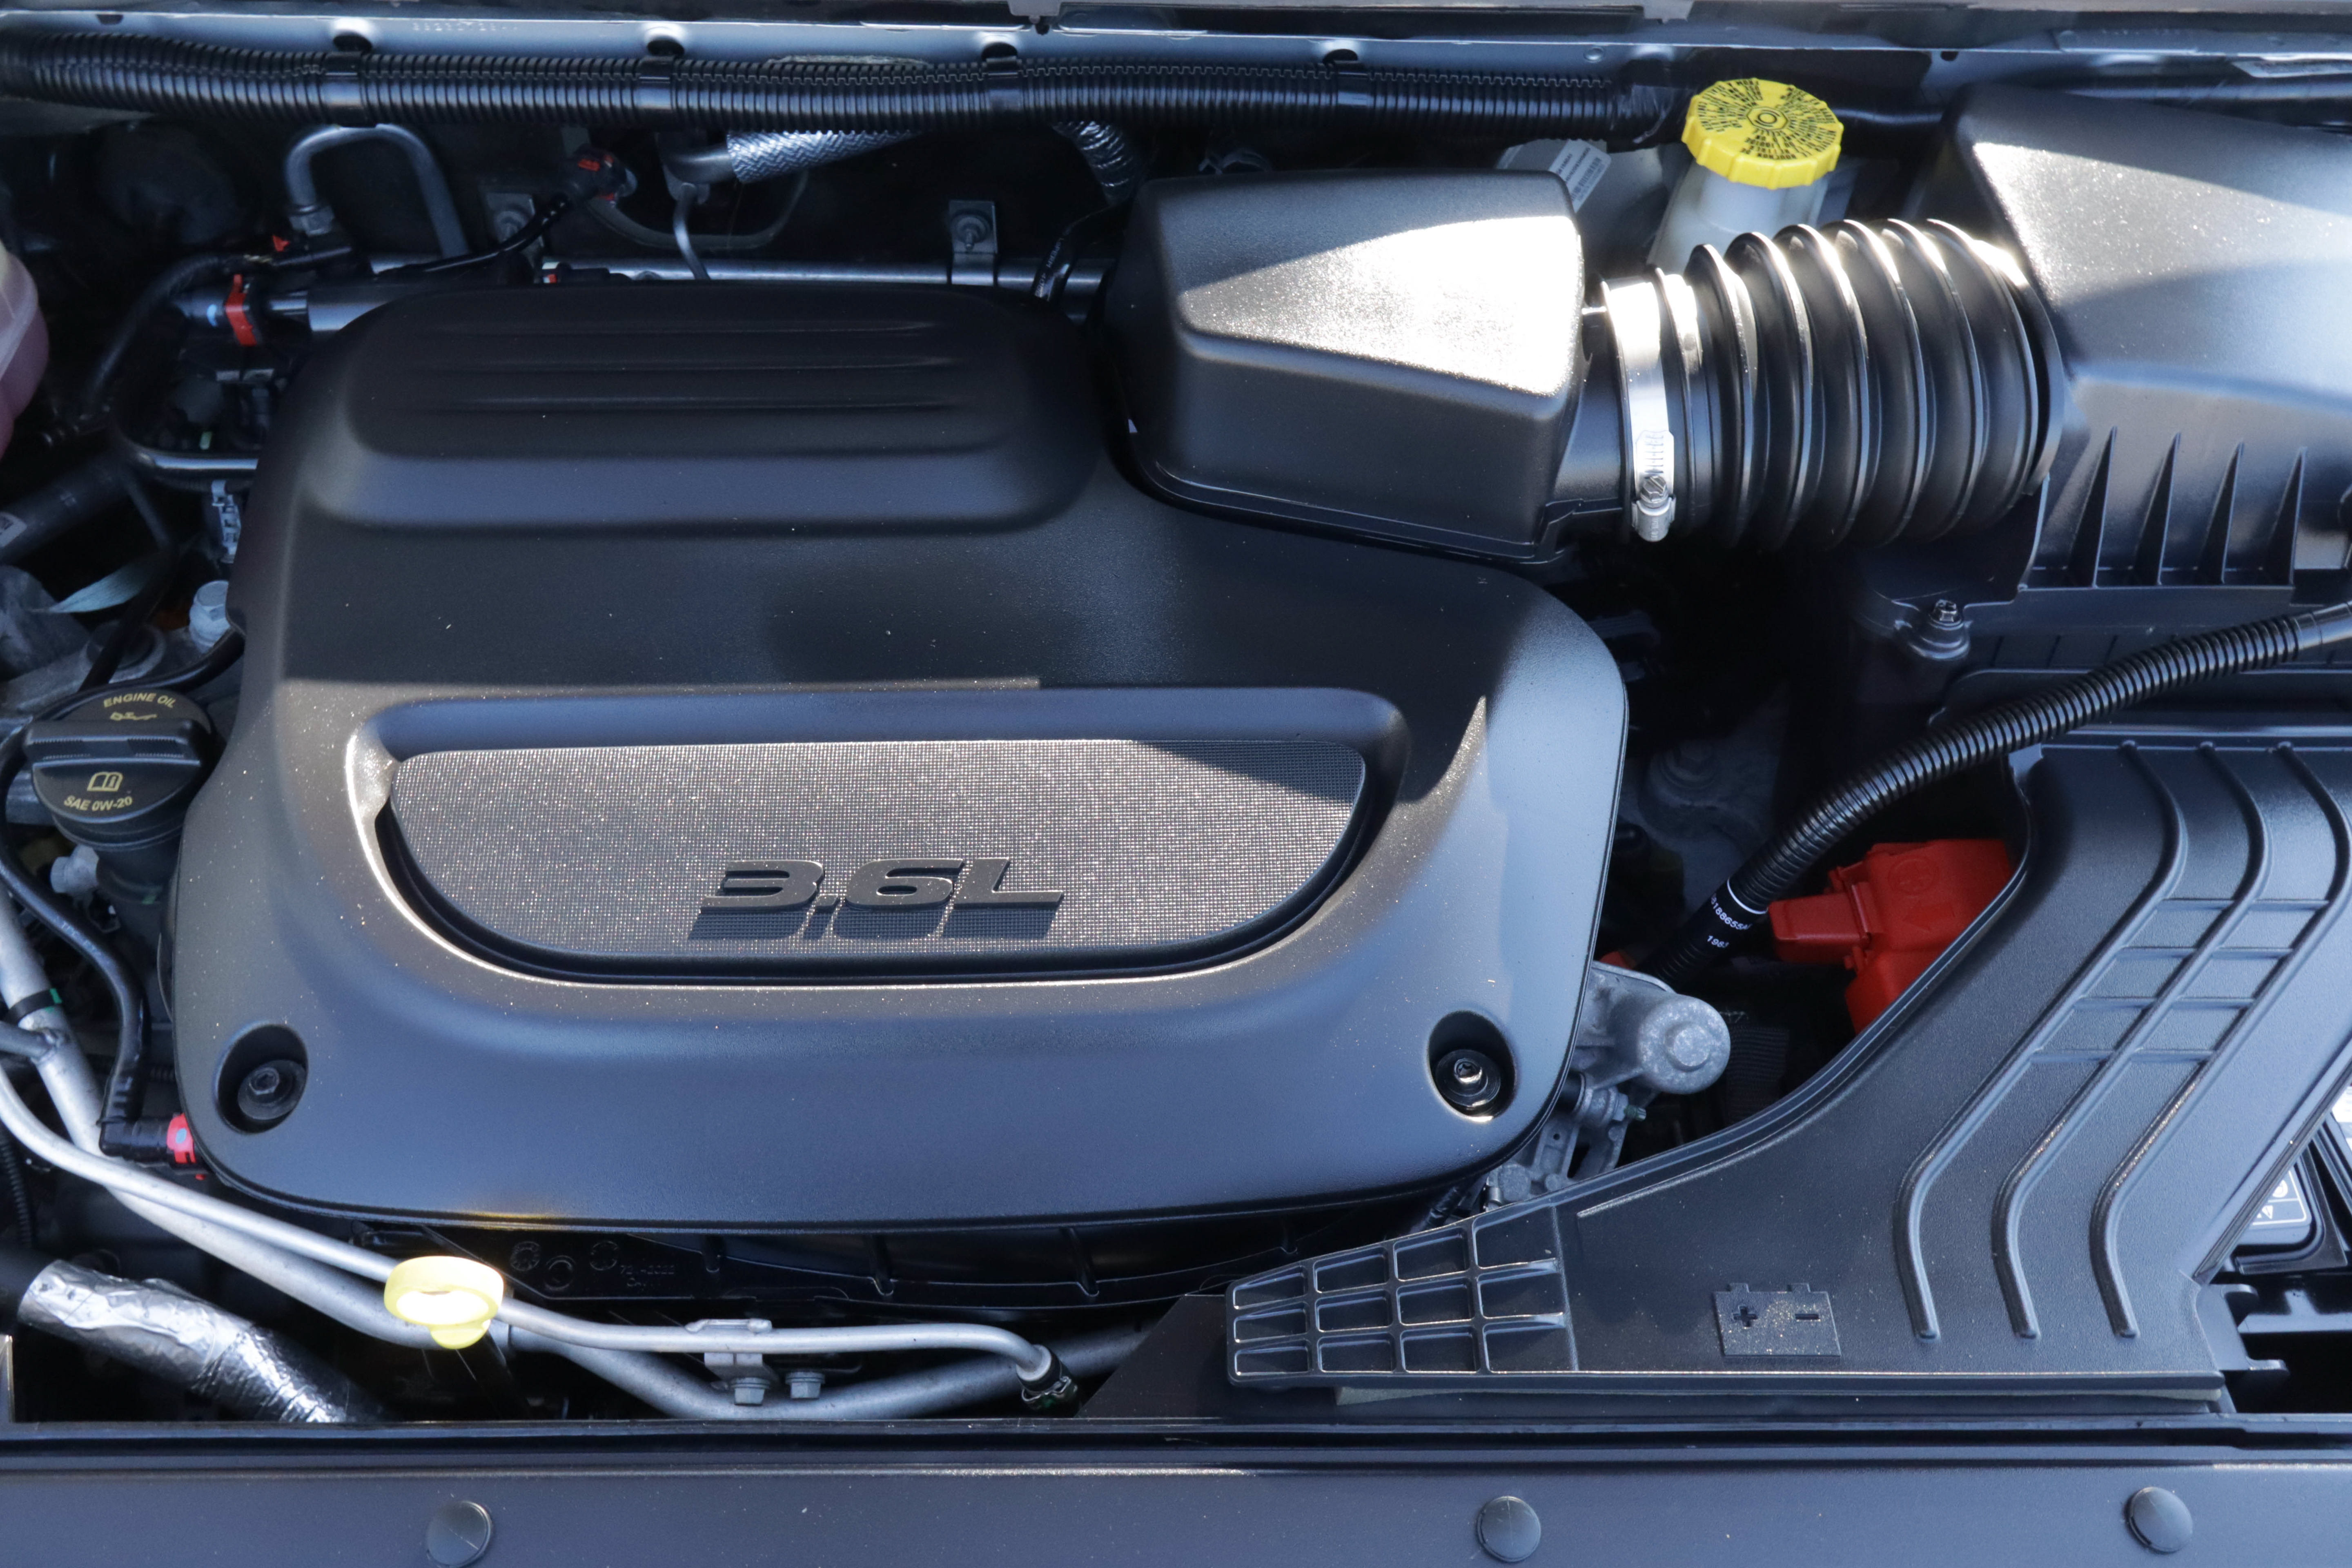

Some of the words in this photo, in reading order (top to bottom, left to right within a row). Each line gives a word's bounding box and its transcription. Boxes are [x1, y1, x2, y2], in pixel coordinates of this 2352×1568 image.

[104, 693, 156, 708] ENGINE
[157, 695, 177, 708] OIL
[64, 795, 89, 811] SAE
[91, 796, 133, 811] 0W-20
[701, 858, 1064, 912] 3.6L
